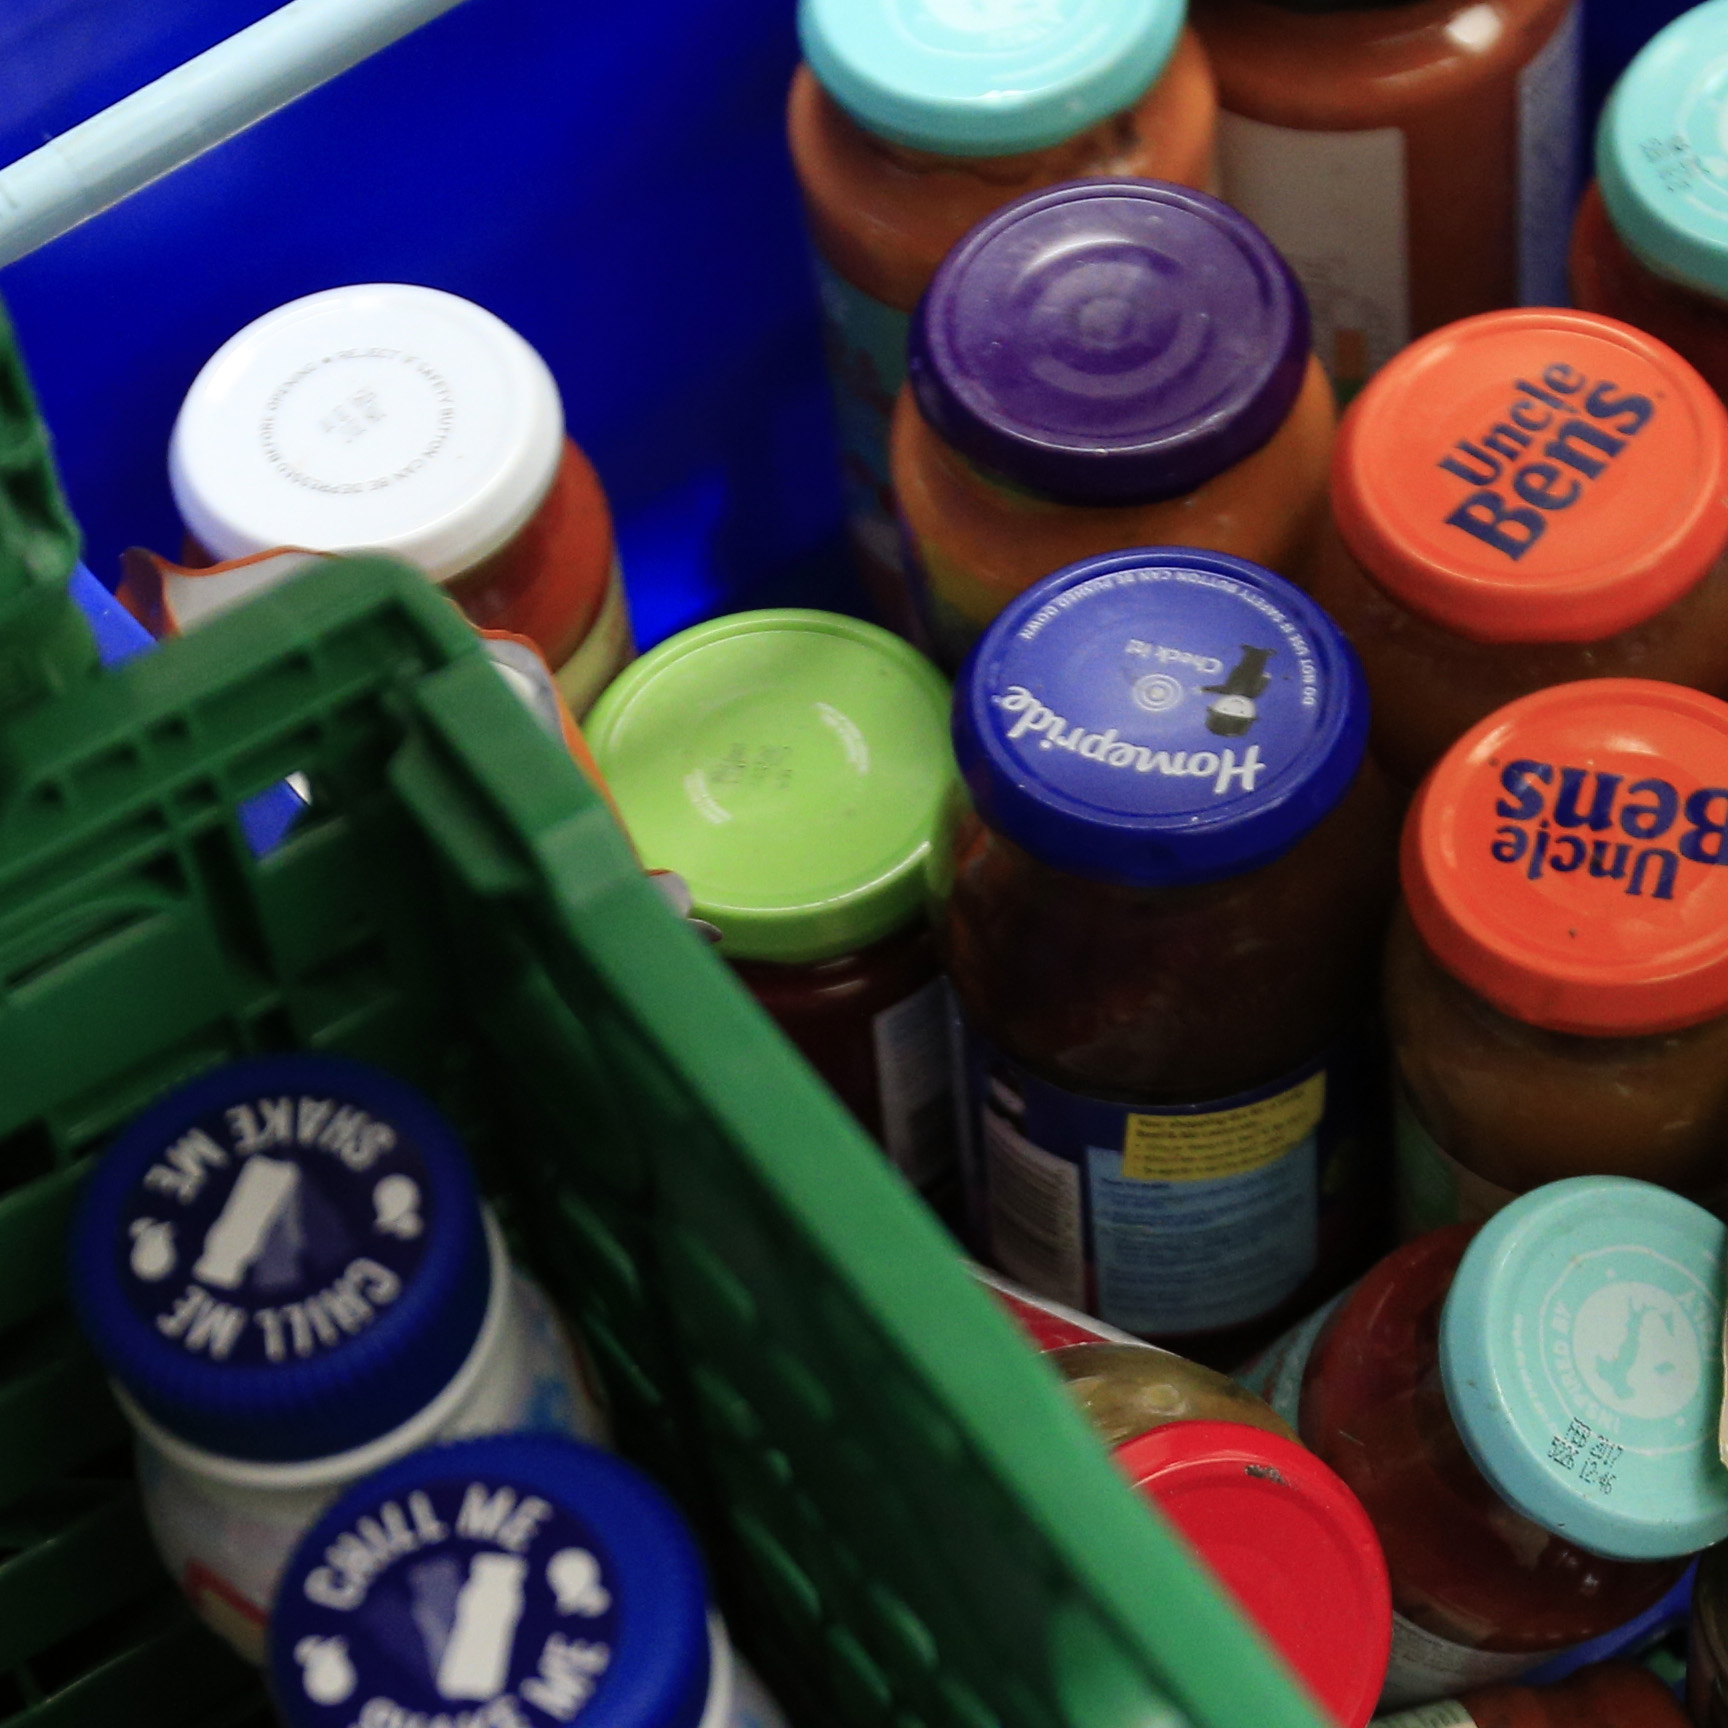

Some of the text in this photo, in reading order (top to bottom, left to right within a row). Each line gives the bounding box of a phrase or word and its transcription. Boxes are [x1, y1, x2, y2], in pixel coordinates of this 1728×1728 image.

[1437, 363, 1587, 487] Uncle
[1444, 379, 1656, 560] Bens
[1136, 569, 1174, 583] CAN
[1175, 571, 1240, 594] BUTTON
[1240, 588, 1288, 624] SAFETY
[1018, 603, 1060, 640] DOWN
[1171, 646, 1224, 676] Check
[1001, 685, 1267, 795] Homepride
[1489, 823, 1681, 900] Uncle
[143, 1095, 397, 1204] SHAKE ME
[154, 1256, 401, 1363] CHILL ME
[1551, 1301, 1572, 1332] BY
[1563, 1416, 1625, 1469] FEB 2017
[303, 1481, 554, 1611] CHILL ME
[519, 1630, 611, 1723] ME
